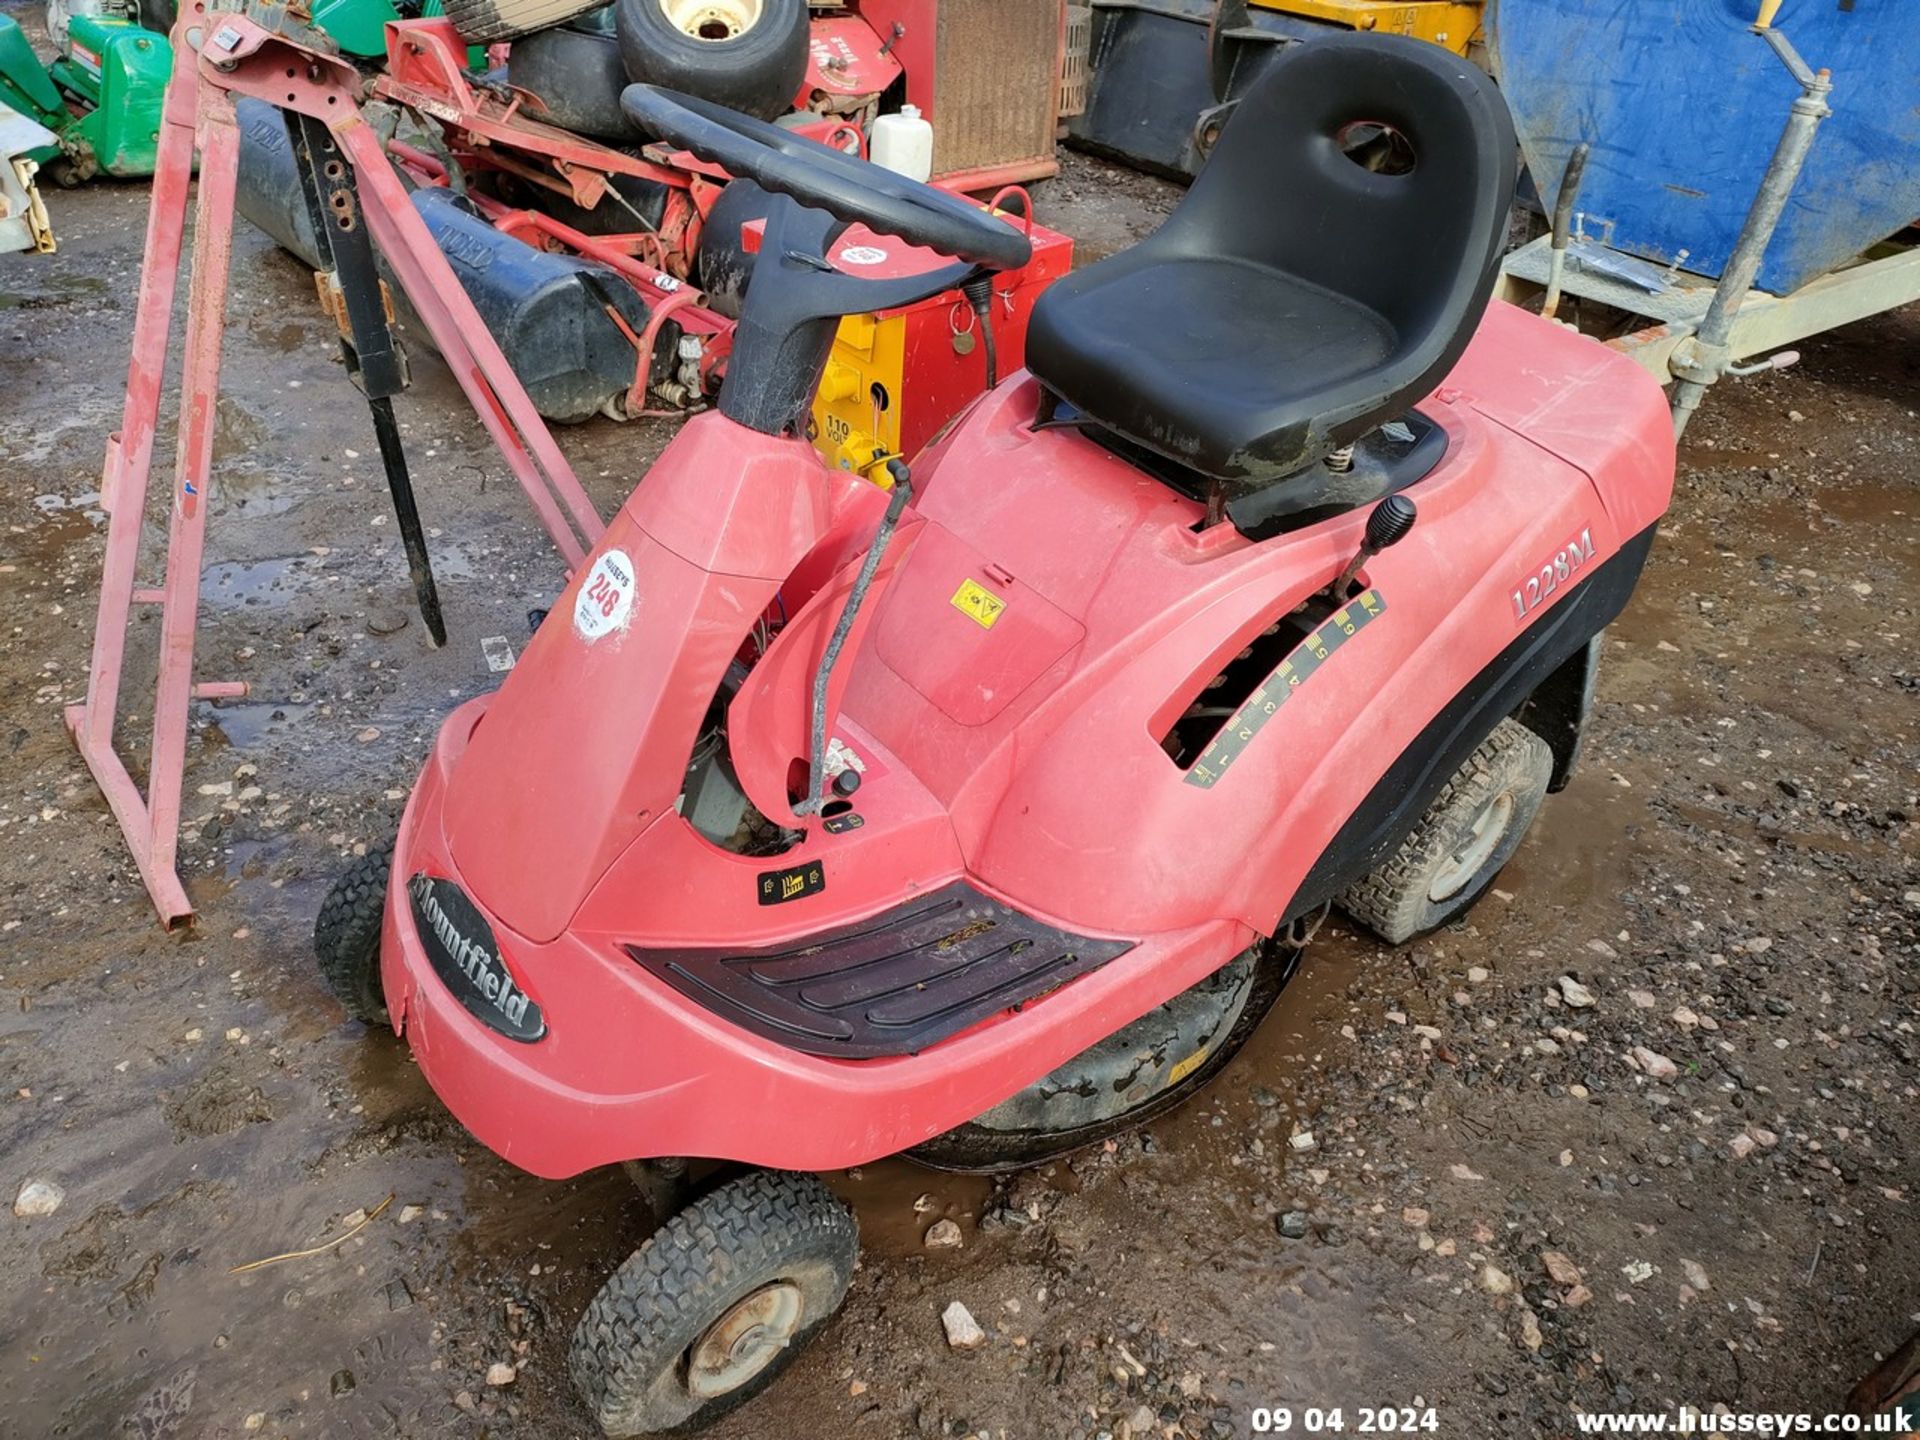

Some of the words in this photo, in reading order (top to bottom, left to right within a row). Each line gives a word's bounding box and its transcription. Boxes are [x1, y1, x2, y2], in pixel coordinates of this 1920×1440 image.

[439, 224, 495, 269] TORO
[827, 415, 849, 436] 110
[587, 572, 620, 617] 246
[604, 556, 630, 588] HUSSEYS
[1512, 527, 1596, 620] 1228M
[1219, 755, 1229, 766] 1
[1239, 728, 1252, 740] 2
[1264, 701, 1276, 714] 3
[1289, 675, 1300, 686] 4
[1316, 647, 1328, 660] 5
[1344, 623, 1356, 636] 6
[1367, 606, 1380, 616] 7
[413, 871, 530, 1027] Mountfield
